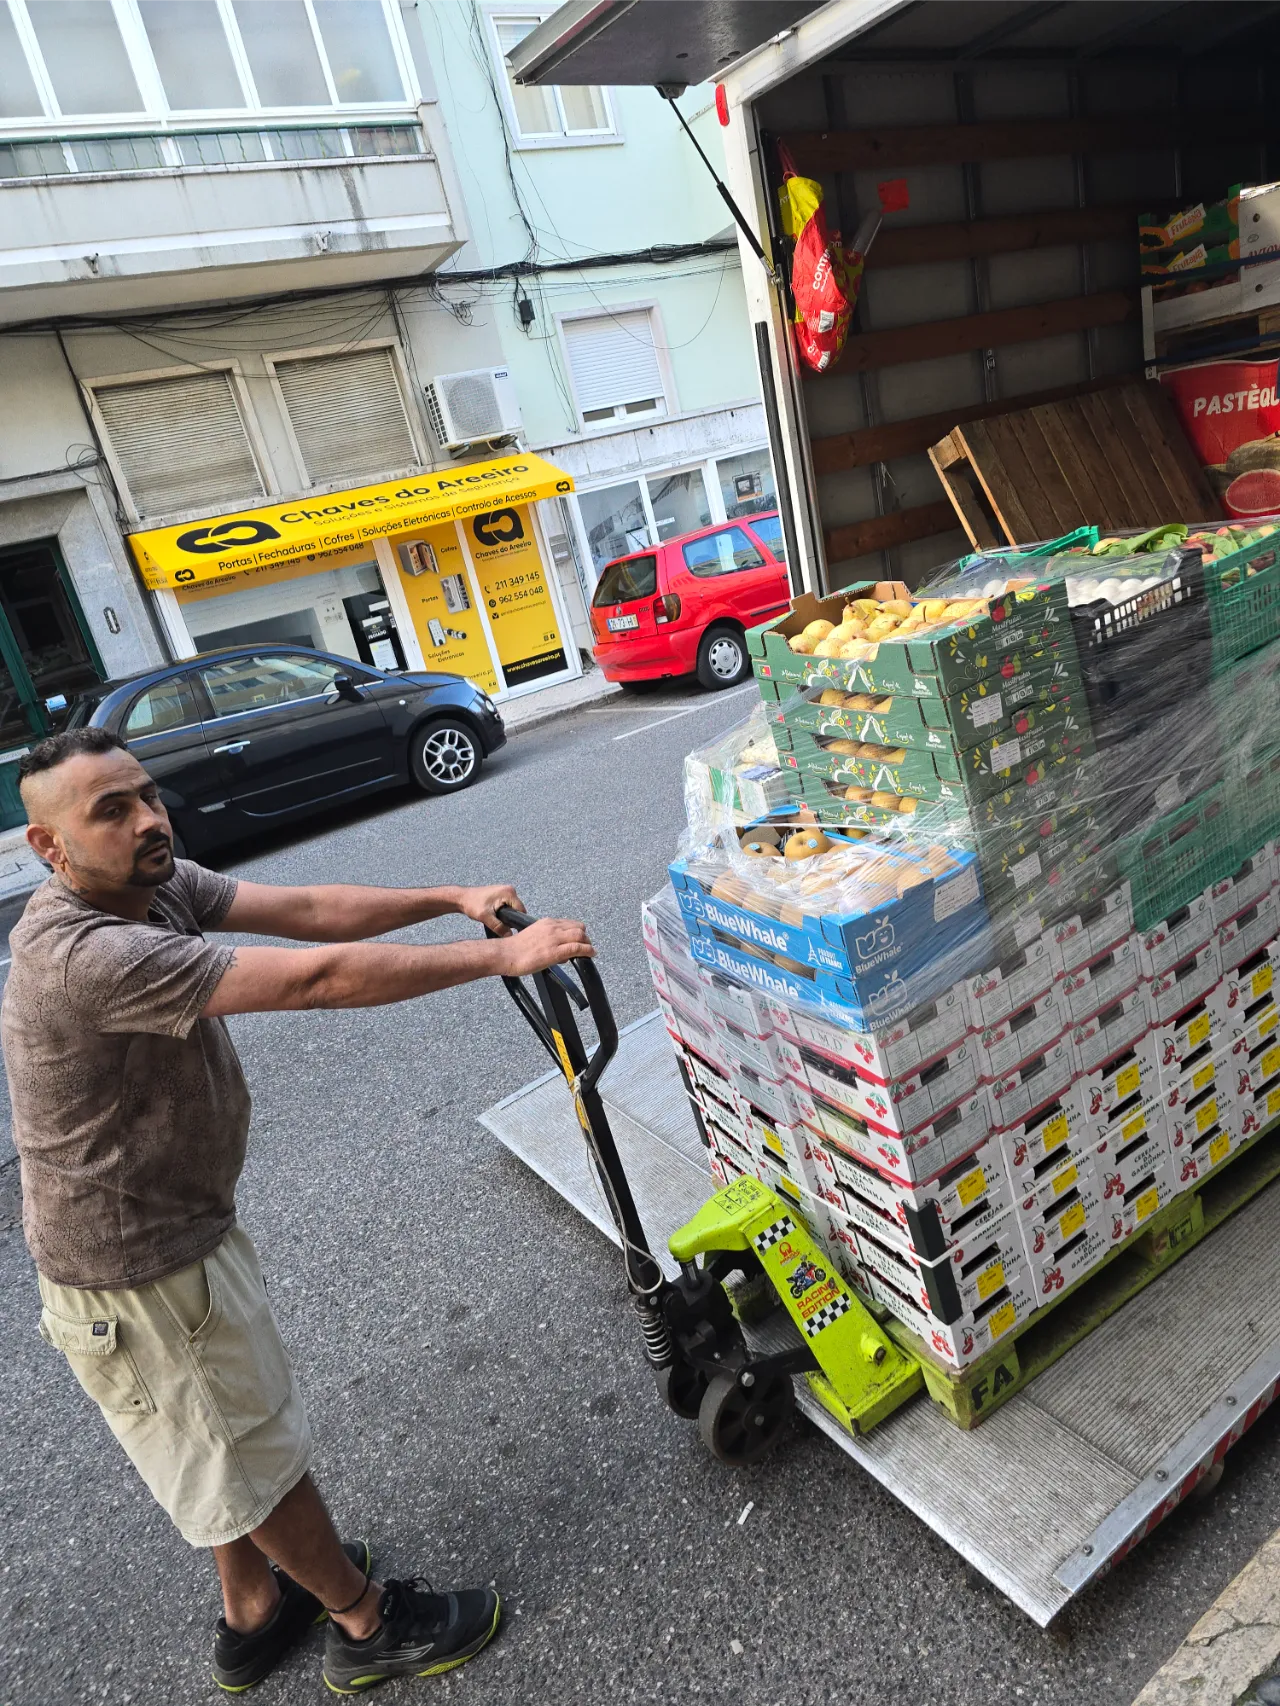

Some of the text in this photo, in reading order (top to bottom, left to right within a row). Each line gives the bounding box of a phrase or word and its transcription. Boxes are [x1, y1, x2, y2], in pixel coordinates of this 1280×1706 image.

[279, 464, 529, 524] Chaves do Areeiro
[313, 477, 521, 527] Soluções e Sistemas de Segurança
[218, 490, 537, 571] Portas Fechaduras Cofres Soluções Eletrónicas Controlo de Acessos
[440, 544, 458, 553] Cofres
[475, 548, 500, 560] Chaves
[509, 540, 532, 551] Areeiro
[495, 571, 541, 591] 211 349 145
[498, 585, 544, 605] 962 554 048
[421, 595, 439, 604] Portas
[1131, 1149, 1166, 1178] GARDUNHA
[1134, 1141, 1160, 1163] CEREJAS
[838, 1170, 886, 1204] GARDUNHA
[839, 1160, 874, 1185] CEREJAS
[856, 1204, 890, 1231] CEREJAS
[974, 1203, 1004, 1227] CEREJAS
[1071, 1238, 1106, 1269] GARDUNHA
[1073, 1231, 1100, 1254] CEREJAS
[868, 1245, 902, 1275] CEREJAS
[986, 1246, 1014, 1270] CEREJAS
[866, 1254, 912, 1293] GARDUNHA
[796, 1280, 834, 1310] RACIN
[801, 1285, 841, 1319] EDITION
[879, 1284, 912, 1314] CEREJAS
[876, 1292, 923, 1333] GARDUNHA
[970, 1363, 1015, 1411] FA
